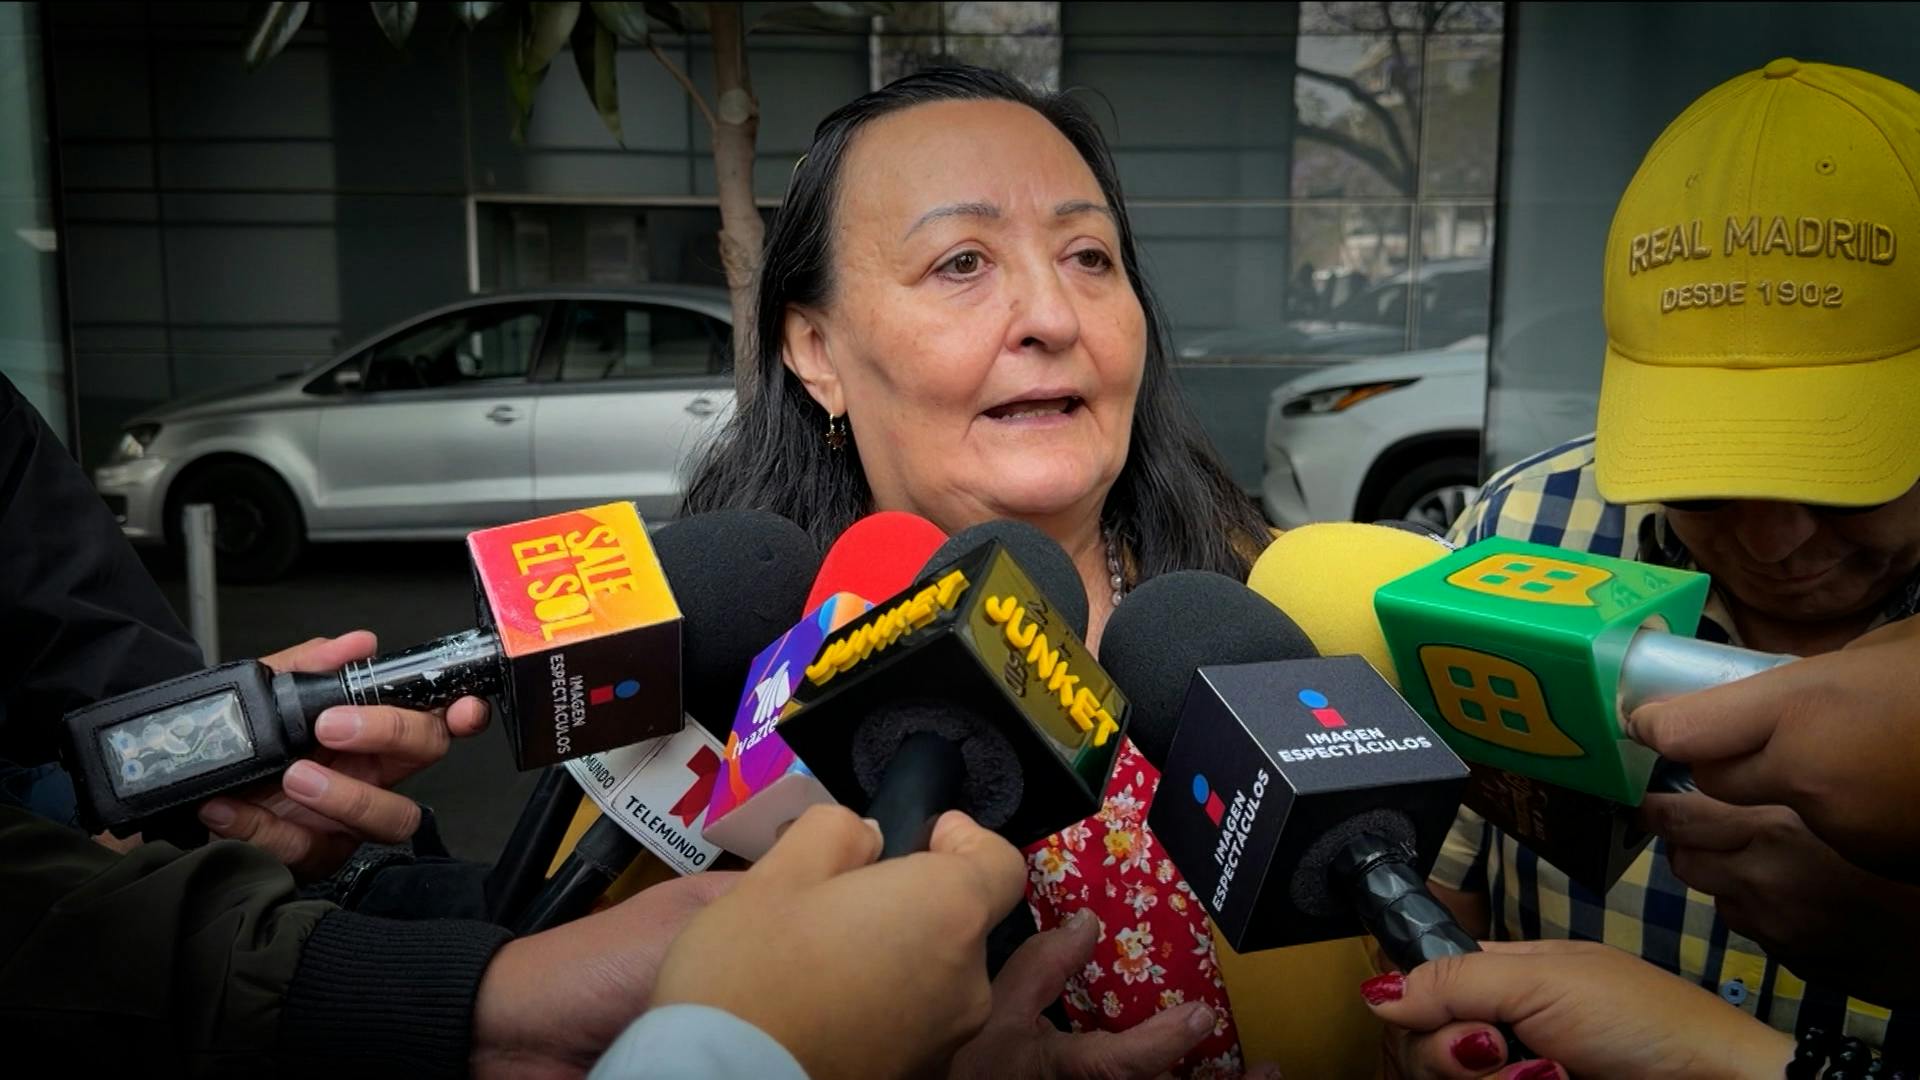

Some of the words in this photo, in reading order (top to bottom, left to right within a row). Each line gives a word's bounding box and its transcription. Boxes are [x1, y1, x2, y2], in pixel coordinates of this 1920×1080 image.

[1629, 220, 1712, 275] REAL
[1724, 214, 1897, 266] MADRID
[1662, 281, 1747, 313] DESDE
[1757, 280, 1843, 308] 1902
[511, 535, 570, 576] EL
[565, 525, 640, 600] SALE
[527, 572, 595, 642] SOL
[569, 674, 586, 728] IMAGEN
[985, 595, 1120, 747] JUNKET
[1305, 727, 1385, 746] IMAGEN
[624, 795, 707, 868] TELEMUNDO
[1214, 789, 1249, 866] IMAGEN
